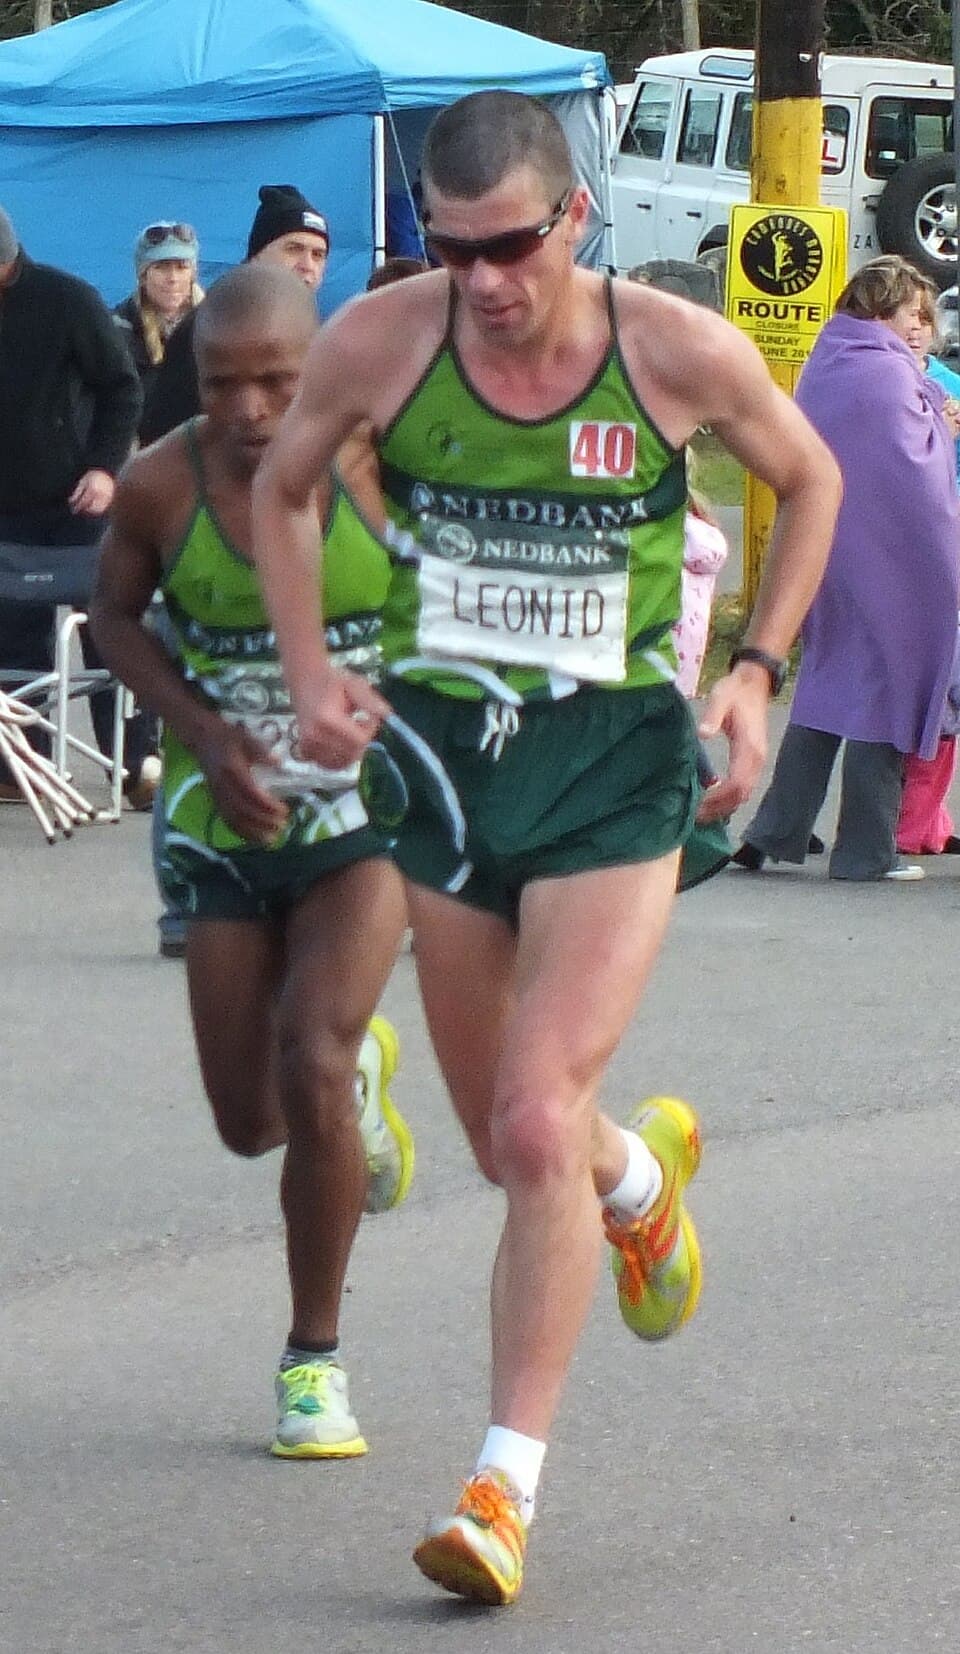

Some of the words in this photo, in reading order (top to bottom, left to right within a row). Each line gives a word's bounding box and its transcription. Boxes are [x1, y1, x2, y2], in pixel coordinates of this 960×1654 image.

[822, 139, 838, 162] L
[737, 301, 821, 322] ROUTE
[755, 320, 800, 331] CLOSURE
[754, 334, 800, 346] SUNDAY
[792, 349, 811, 358] 201
[572, 424, 635, 475] 40
[442, 494, 648, 527] NEDBANK
[483, 538, 611, 564] NEDBANK
[453, 577, 605, 637] LEONID
